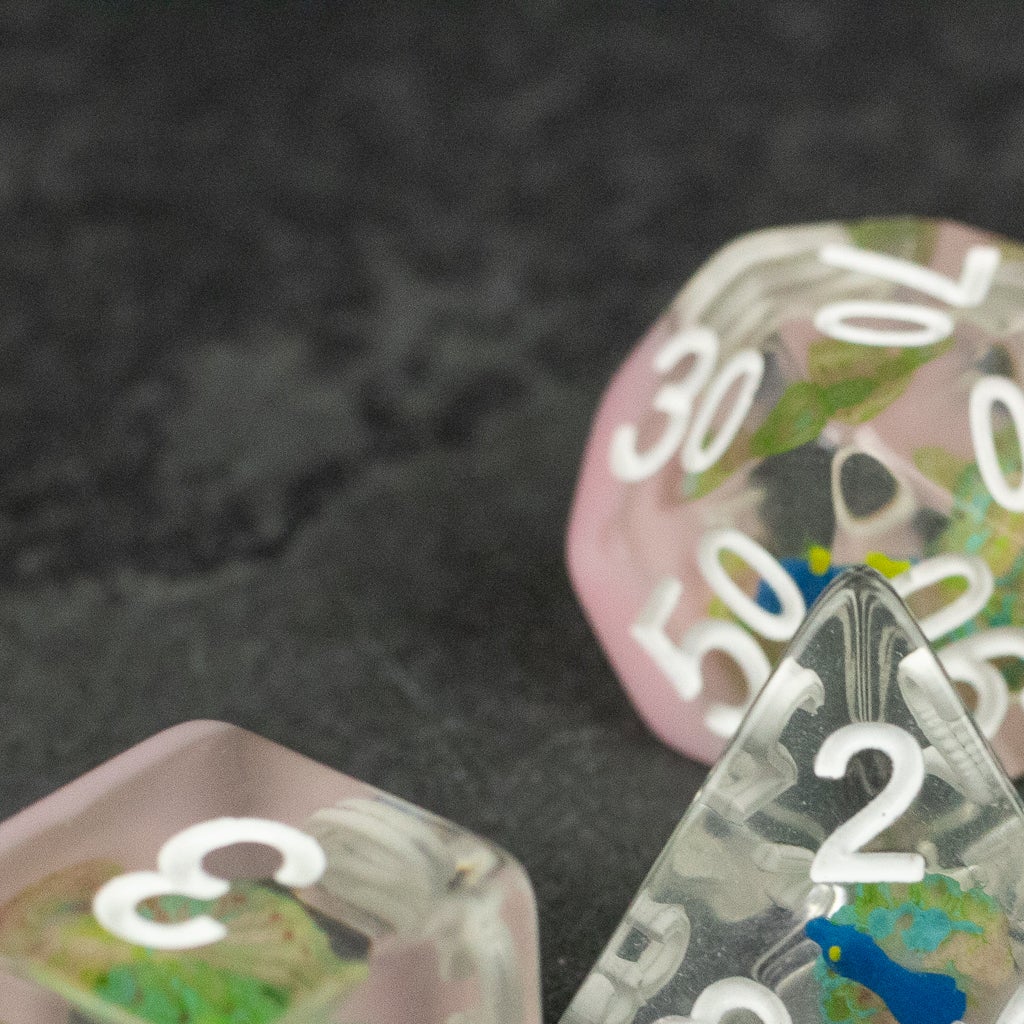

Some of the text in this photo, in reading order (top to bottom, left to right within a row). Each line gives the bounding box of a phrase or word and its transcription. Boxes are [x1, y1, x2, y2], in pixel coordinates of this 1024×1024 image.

[610, 327, 765, 482] 30
[632, 528, 805, 738] 50
[810, 722, 925, 884] 2
[93, 817, 328, 949] 3
